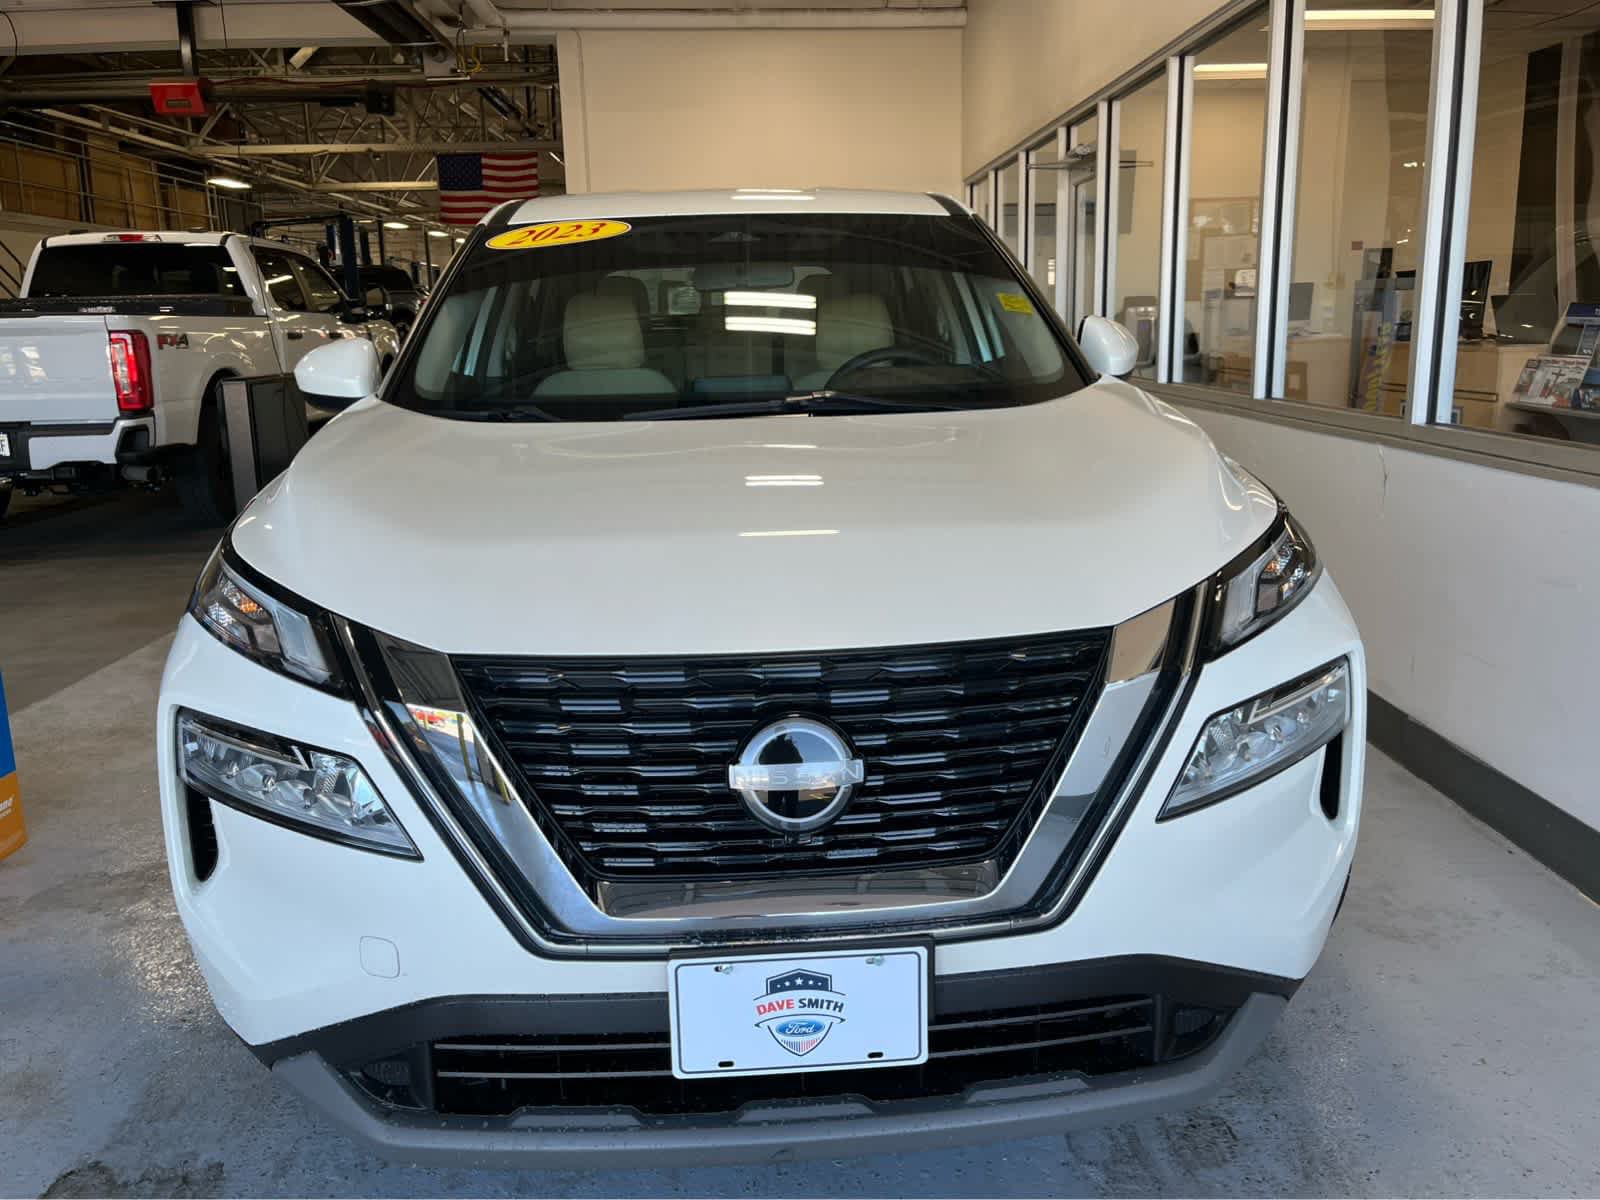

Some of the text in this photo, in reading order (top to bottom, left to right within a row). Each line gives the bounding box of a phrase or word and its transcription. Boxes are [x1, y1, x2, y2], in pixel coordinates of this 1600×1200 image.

[508, 222, 607, 246] 2023
[756, 998, 844, 1016] DAVE SMITH
[785, 1023, 814, 1034] Ford
